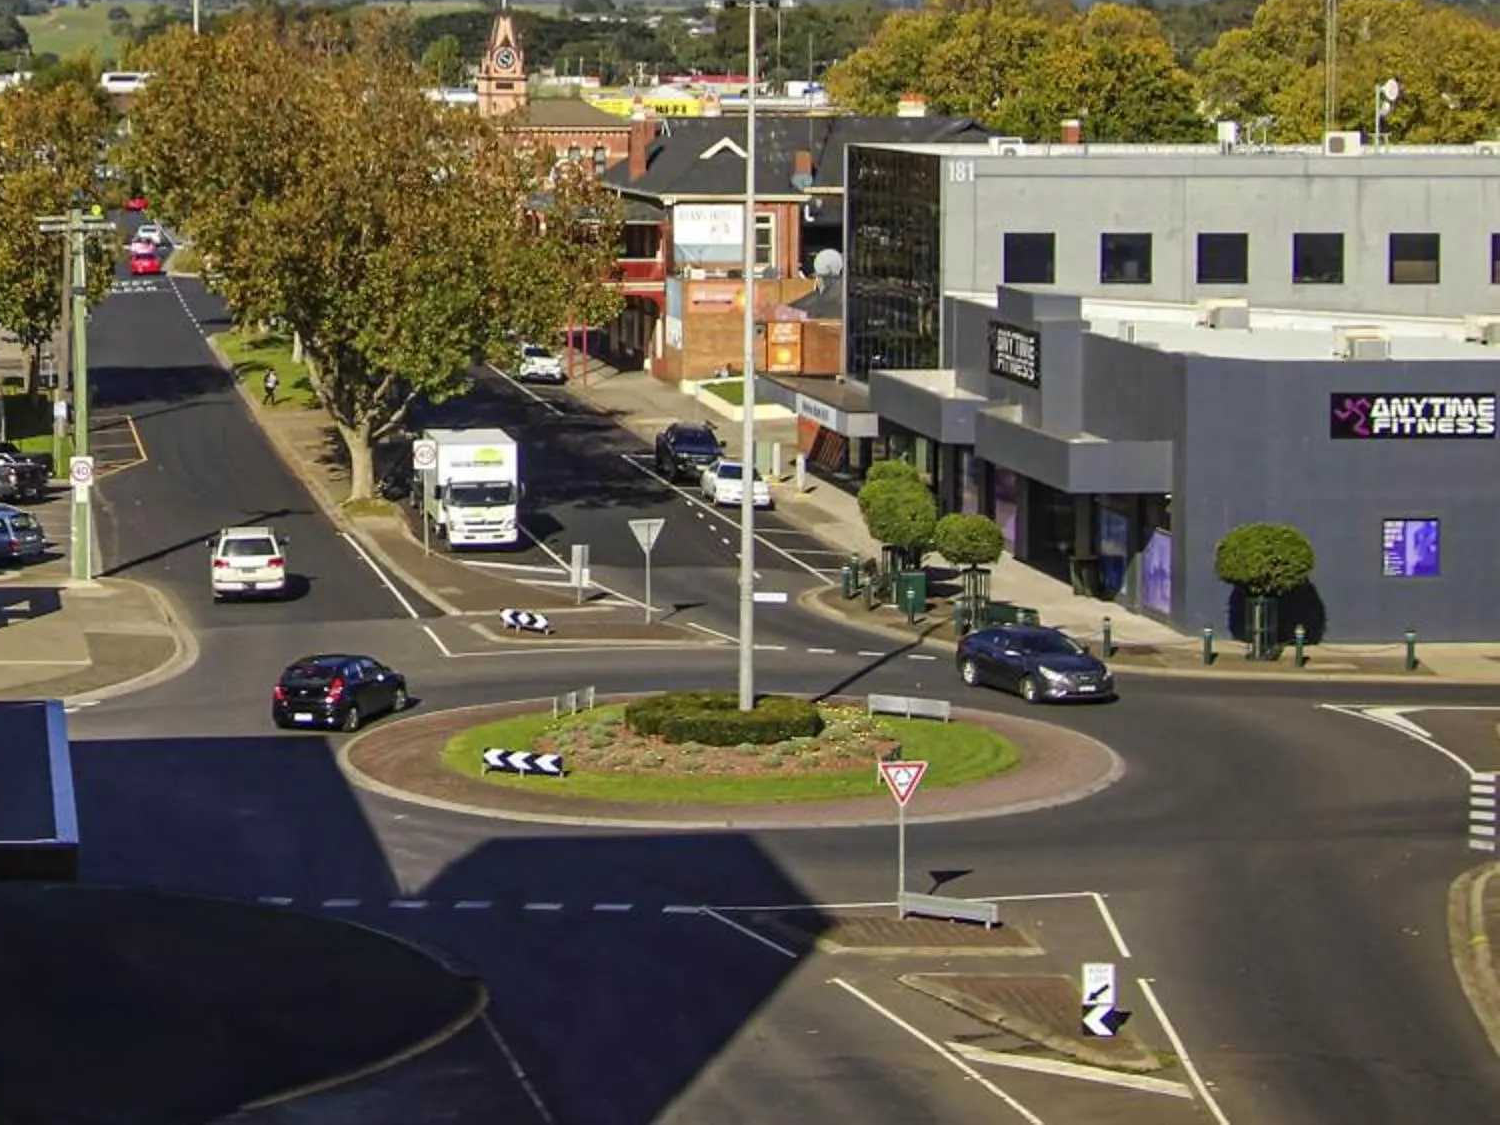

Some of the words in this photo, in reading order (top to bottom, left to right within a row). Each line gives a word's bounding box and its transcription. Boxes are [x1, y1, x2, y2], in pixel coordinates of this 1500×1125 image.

[950, 161, 974, 182] 181
[997, 352, 1035, 380] FITNESS
[1370, 397, 1496, 418] ANYTIME
[1373, 417, 1496, 435] FITNESS
[75, 466, 89, 476] 40
